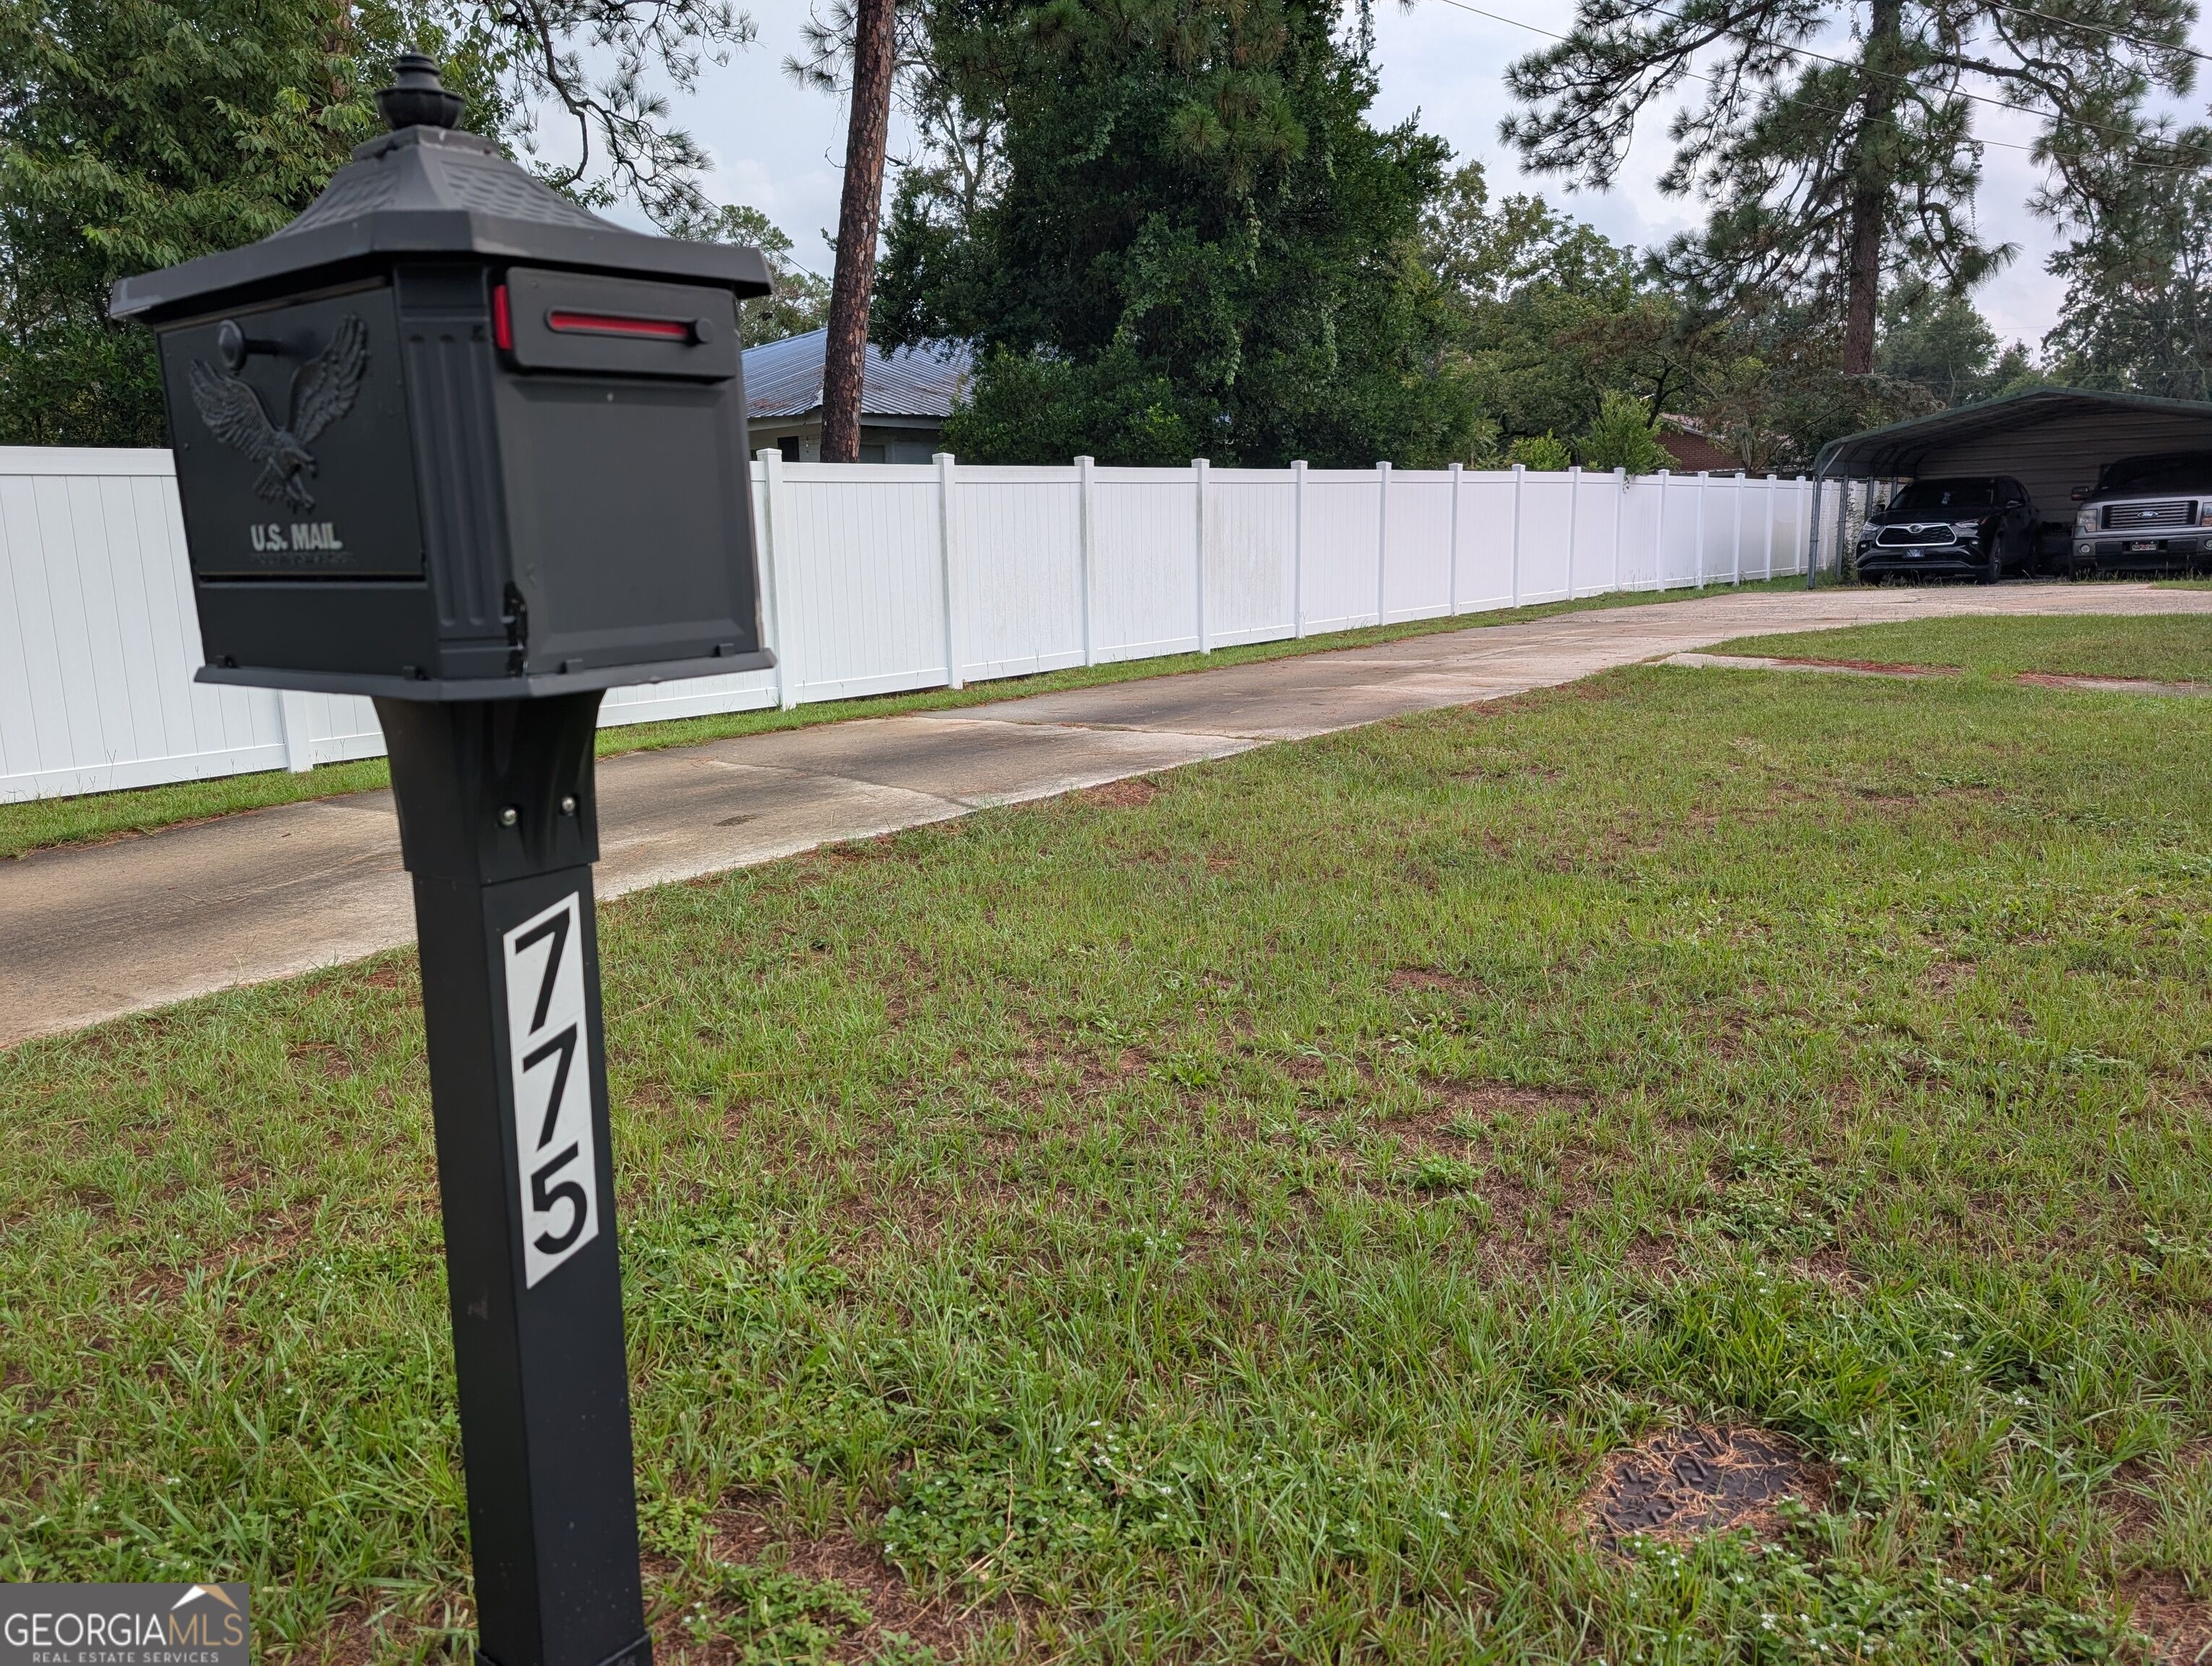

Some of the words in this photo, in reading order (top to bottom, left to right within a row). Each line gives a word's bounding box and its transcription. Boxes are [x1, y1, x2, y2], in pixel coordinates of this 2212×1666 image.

[250, 523, 288, 552] U.S.
[291, 522, 343, 550] MAIL
[514, 906, 587, 1255] 775
